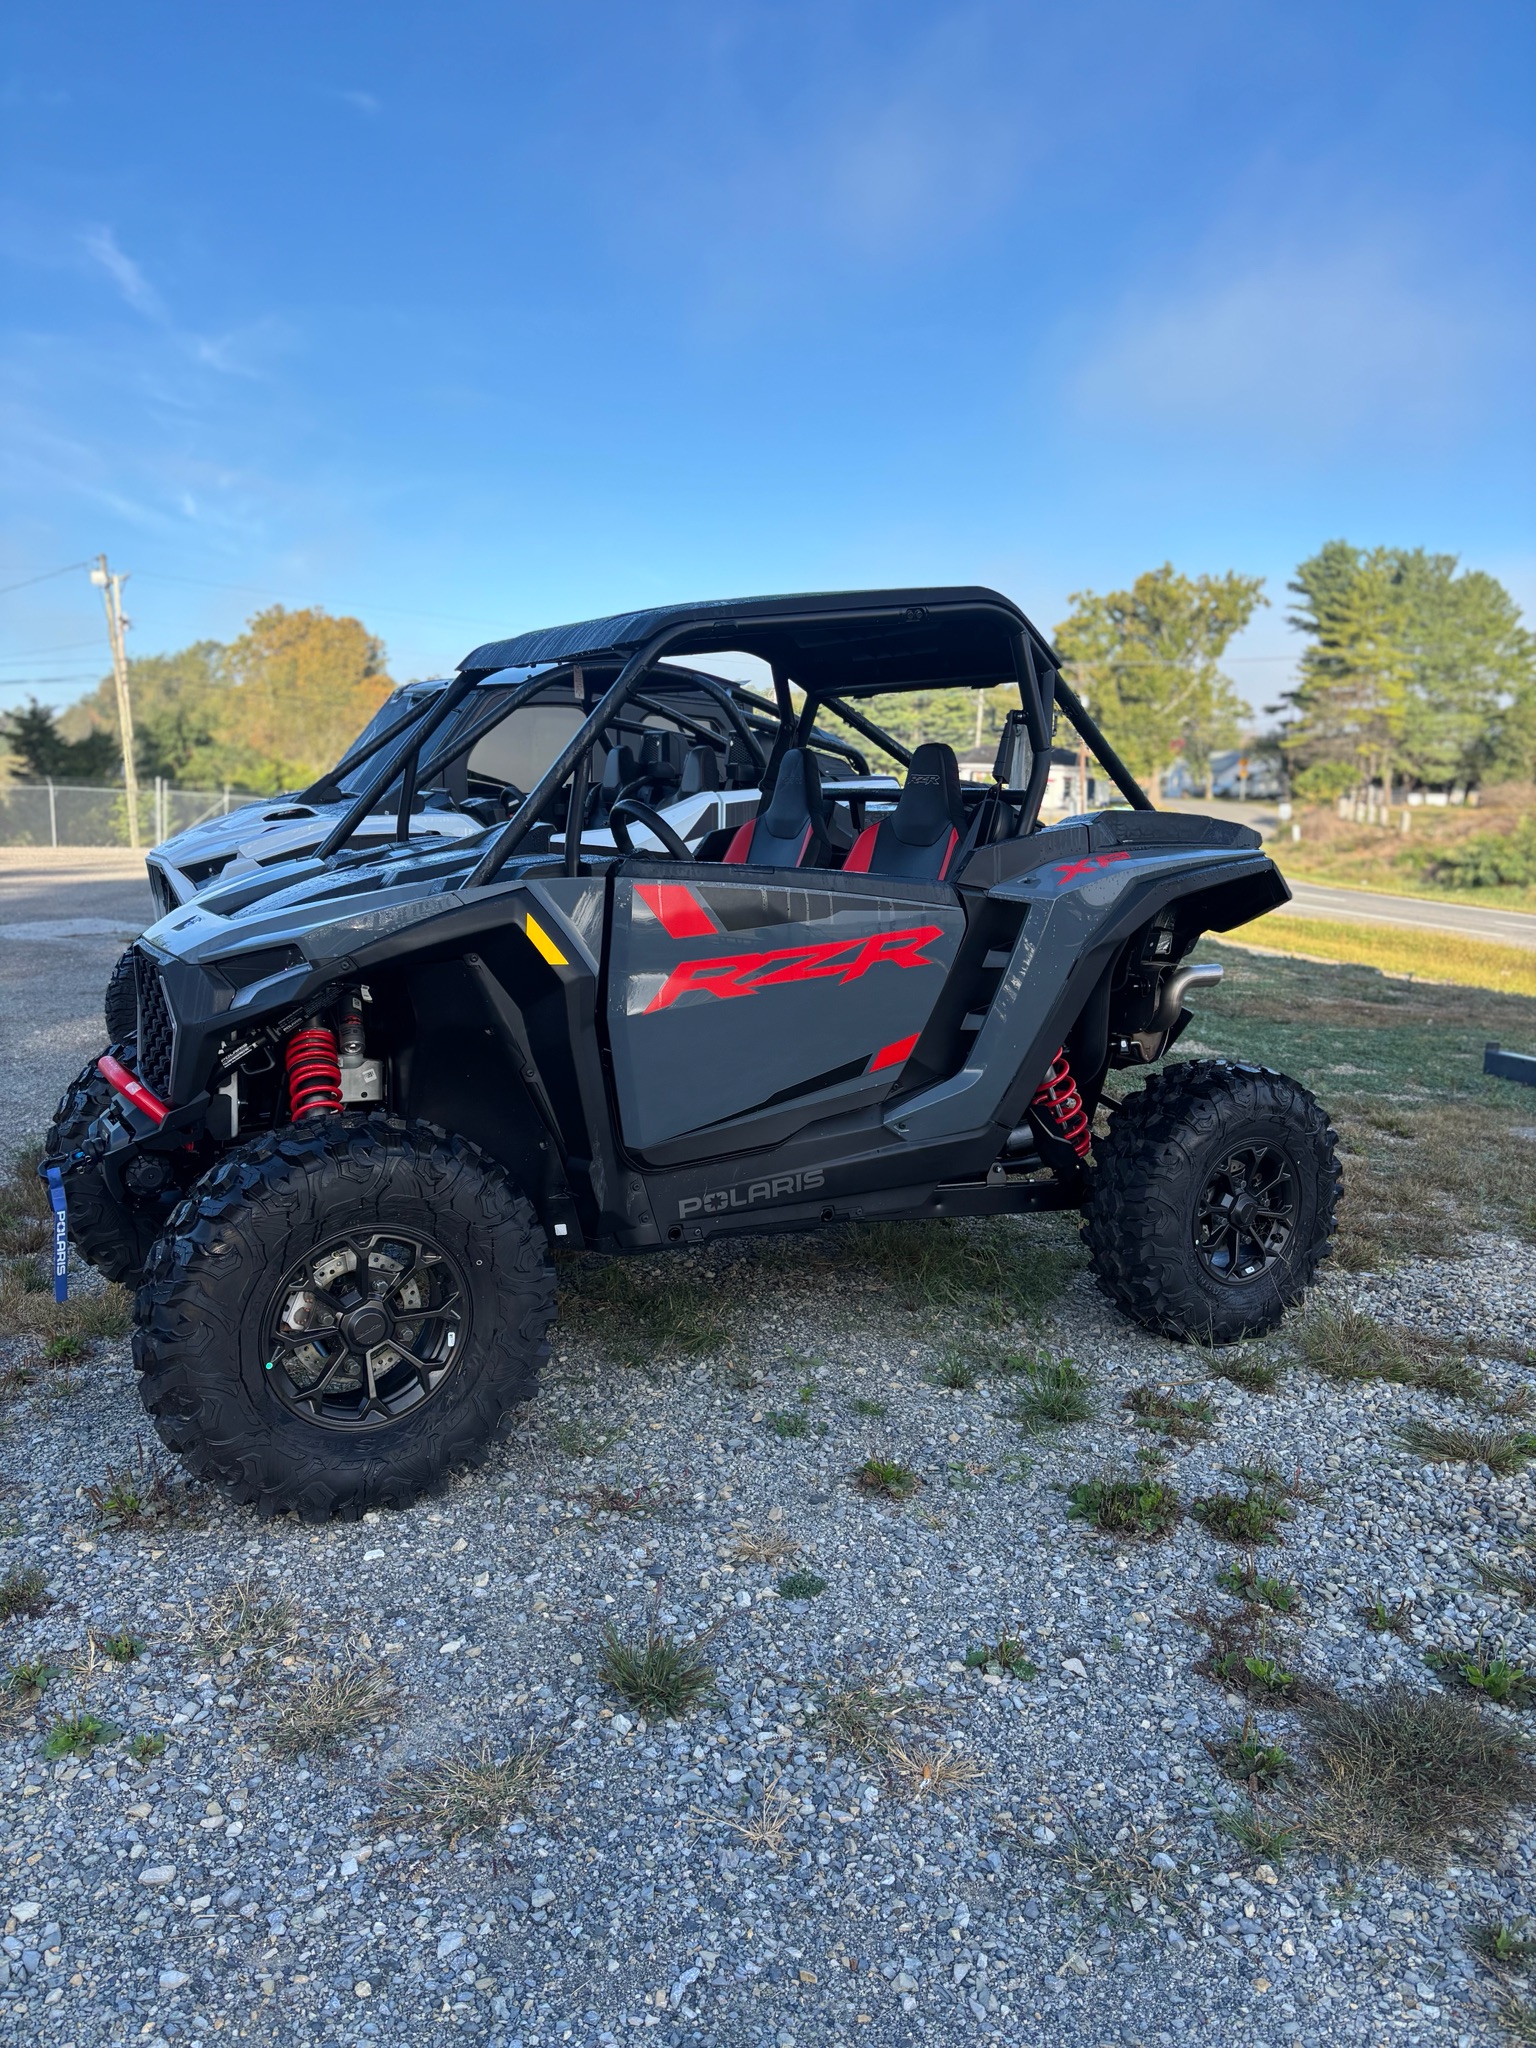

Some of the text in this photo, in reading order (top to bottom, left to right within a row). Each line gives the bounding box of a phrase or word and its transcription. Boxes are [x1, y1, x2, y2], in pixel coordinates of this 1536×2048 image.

[907, 774, 941, 785] RZR
[1052, 851, 1132, 887] XP
[642, 925, 945, 1016] RZR
[678, 1168, 826, 1220] POLARIS
[56, 1210, 66, 1276] POLARIS
